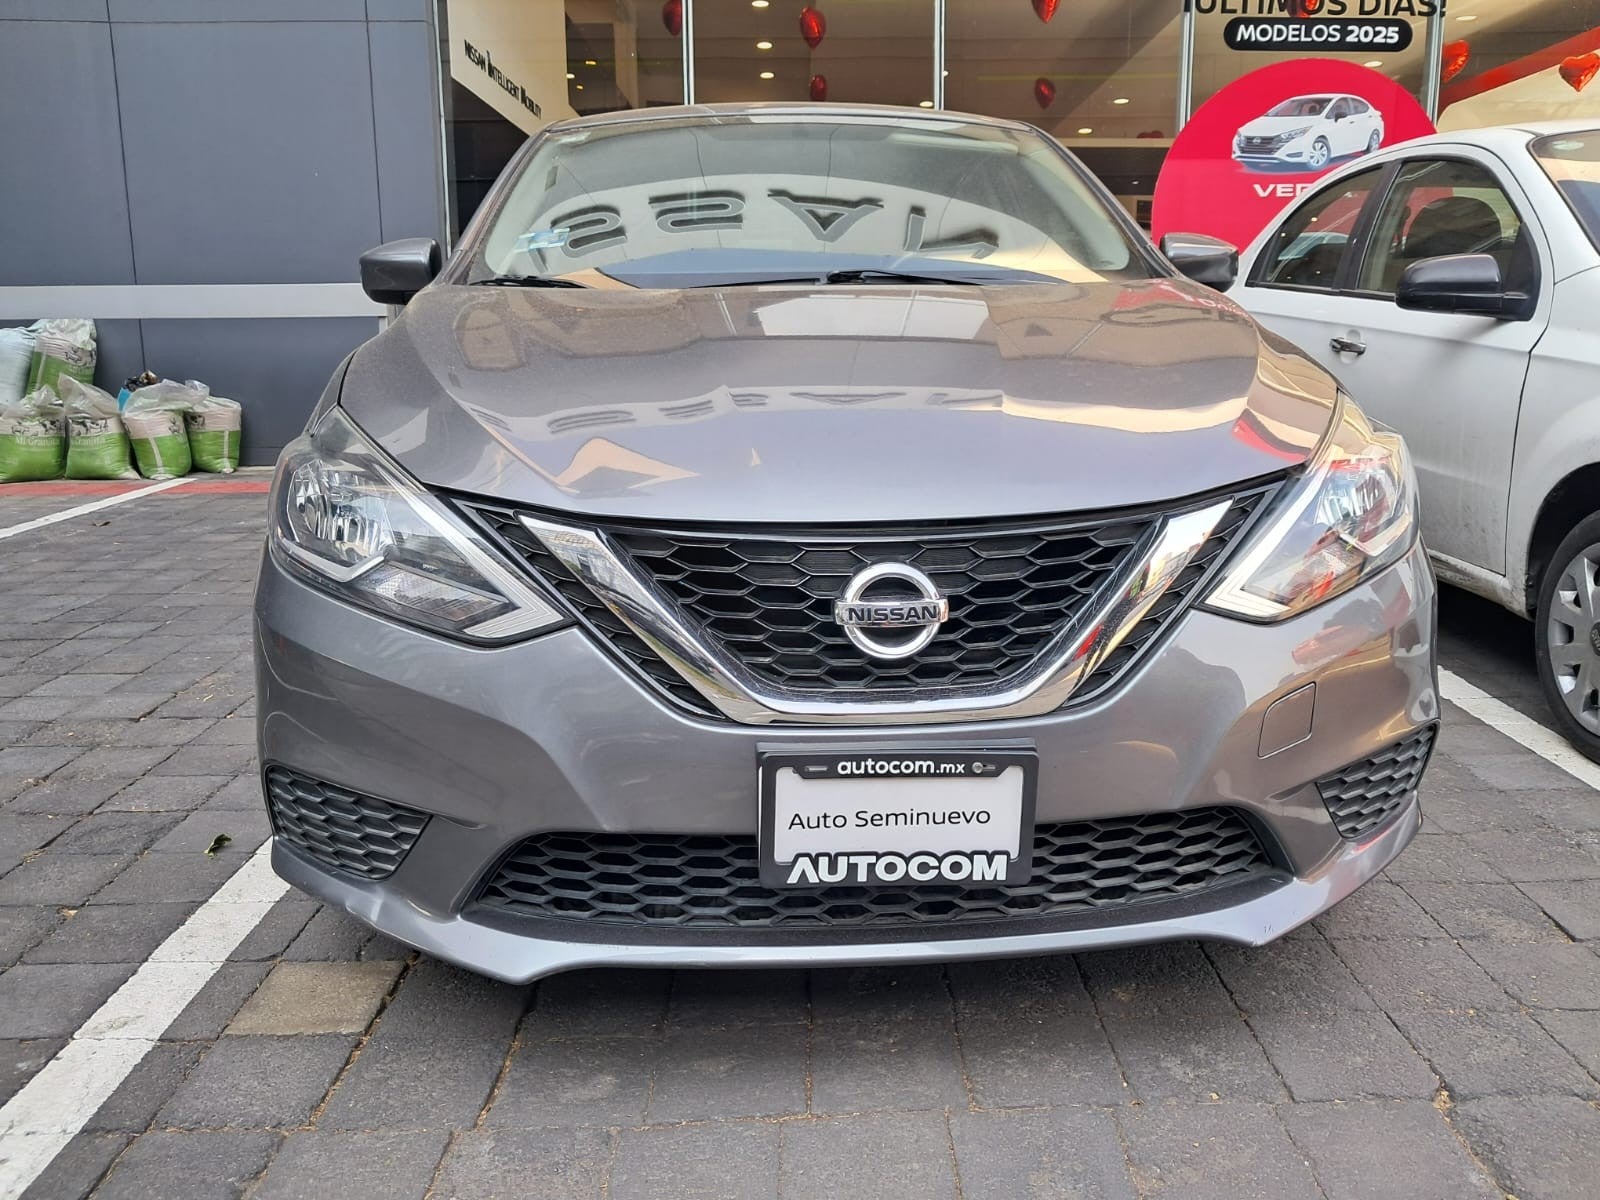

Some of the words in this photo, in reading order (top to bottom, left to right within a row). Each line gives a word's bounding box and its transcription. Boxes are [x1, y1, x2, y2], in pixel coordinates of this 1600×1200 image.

[1235, 24, 1341, 43] MODELOS
[1345, 25, 1400, 44] 2025
[464, 38, 487, 73] NISSAN
[486, 50, 520, 101] INTELLIGENT
[520, 85, 542, 120] MOBILITY
[848, 604, 937, 622] NISSAN
[837, 758, 966, 775] autocom.mx
[788, 812, 848, 830] Auto
[854, 808, 991, 828] Seminuevo
[786, 853, 1008, 884] AUTOCOM
